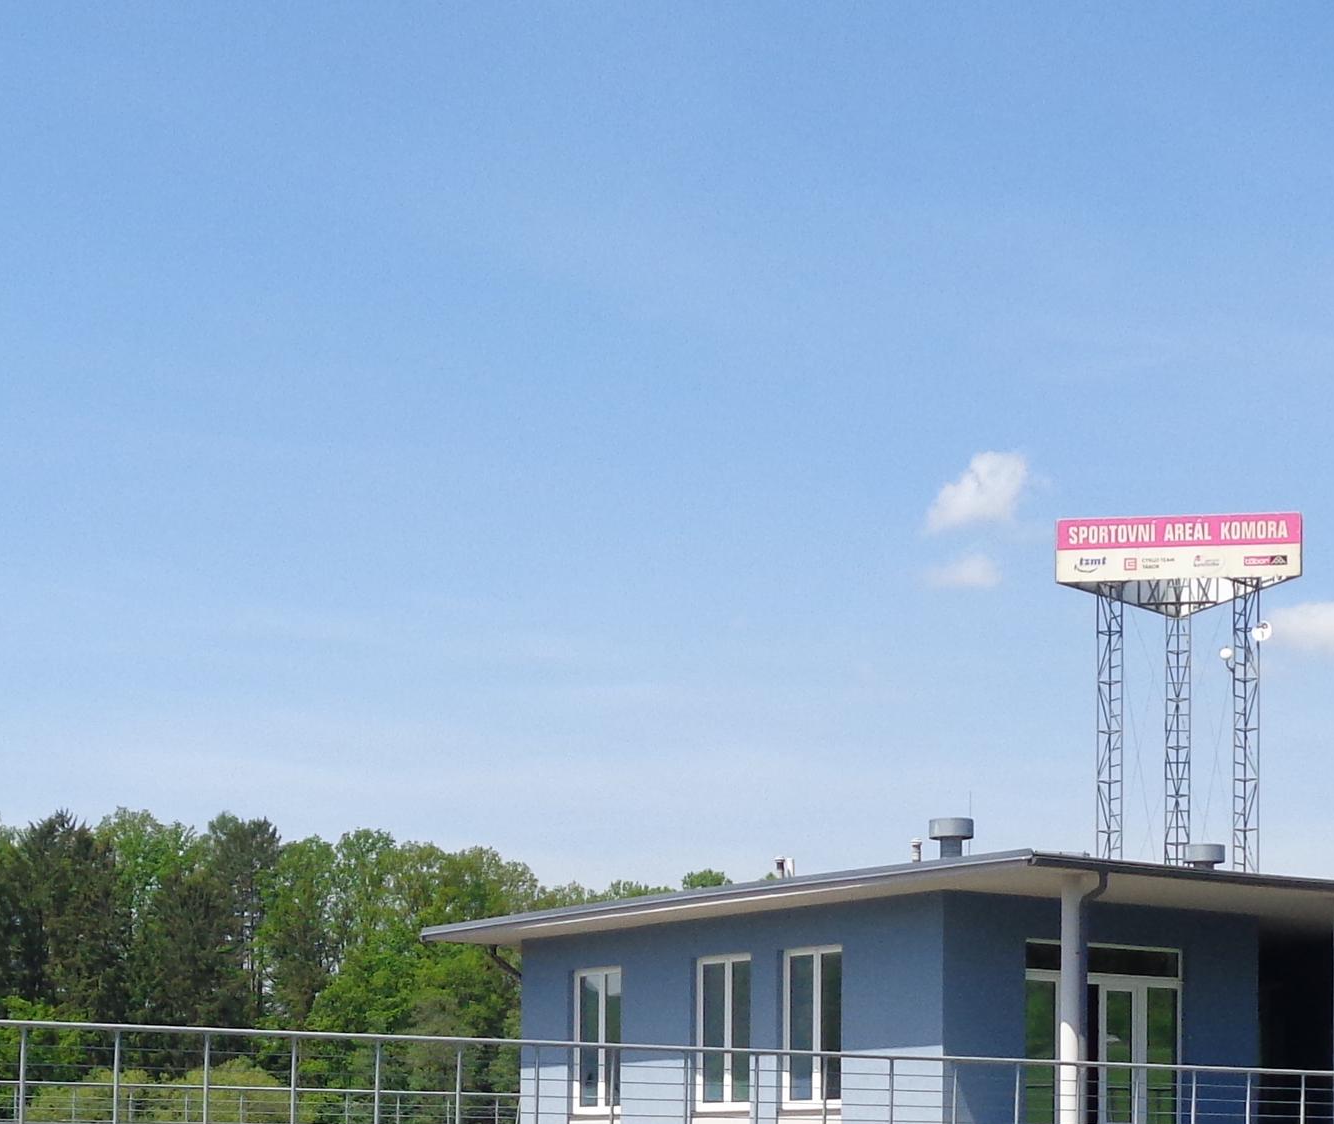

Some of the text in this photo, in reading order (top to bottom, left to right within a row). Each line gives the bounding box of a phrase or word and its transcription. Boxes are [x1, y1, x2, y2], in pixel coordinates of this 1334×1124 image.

[1068, 519, 1288, 545] SPORTOVNÍ AREÁL KOMORA
